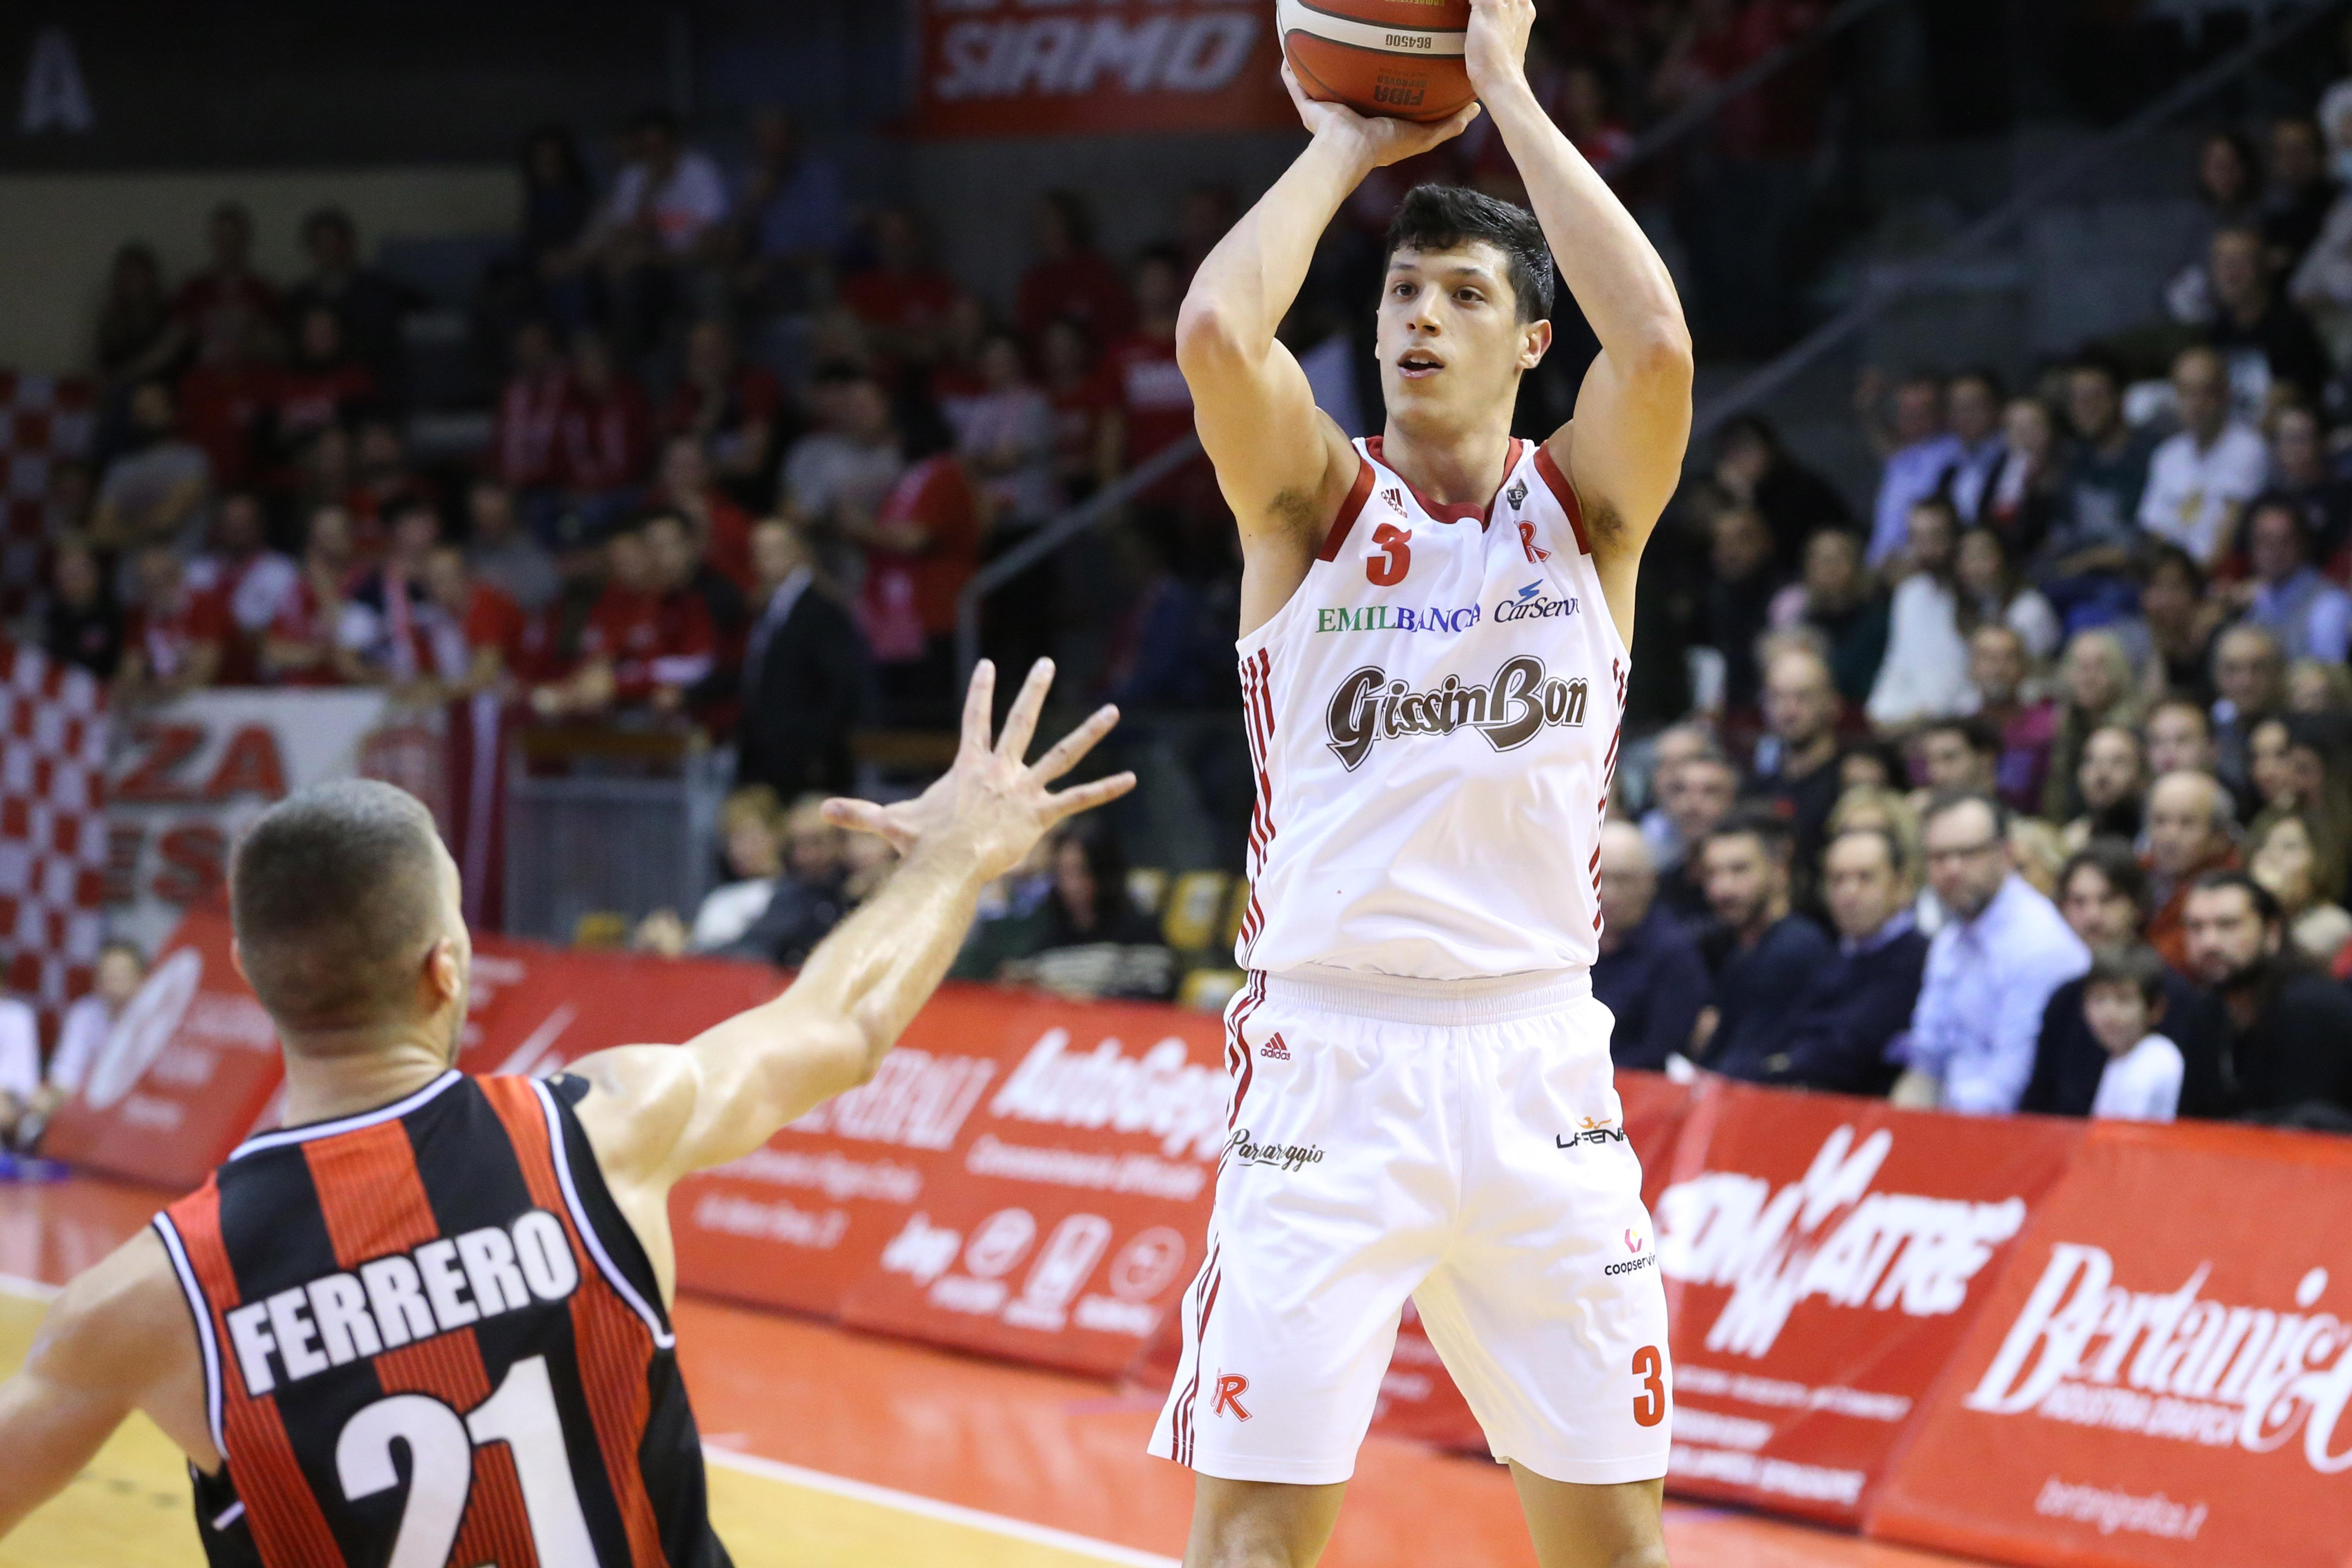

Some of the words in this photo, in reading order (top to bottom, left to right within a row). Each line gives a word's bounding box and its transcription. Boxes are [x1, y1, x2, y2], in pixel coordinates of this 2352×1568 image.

[1386, 34, 1432, 49] BG4500
[935, 16, 1256, 100] SIAMO
[1374, 85, 1425, 106] FIBA
[1381, 491, 1408, 518] adidas
[1508, 490, 1523, 501] LB
[1366, 523, 1412, 586] 3
[1315, 602, 1481, 633] EMILBANCA
[1260, 1047, 1291, 1060] adidas
[224, 1209, 580, 1398] FERRERO
[1631, 1345, 1665, 1427] 3
[335, 1353, 601, 1568] 21
